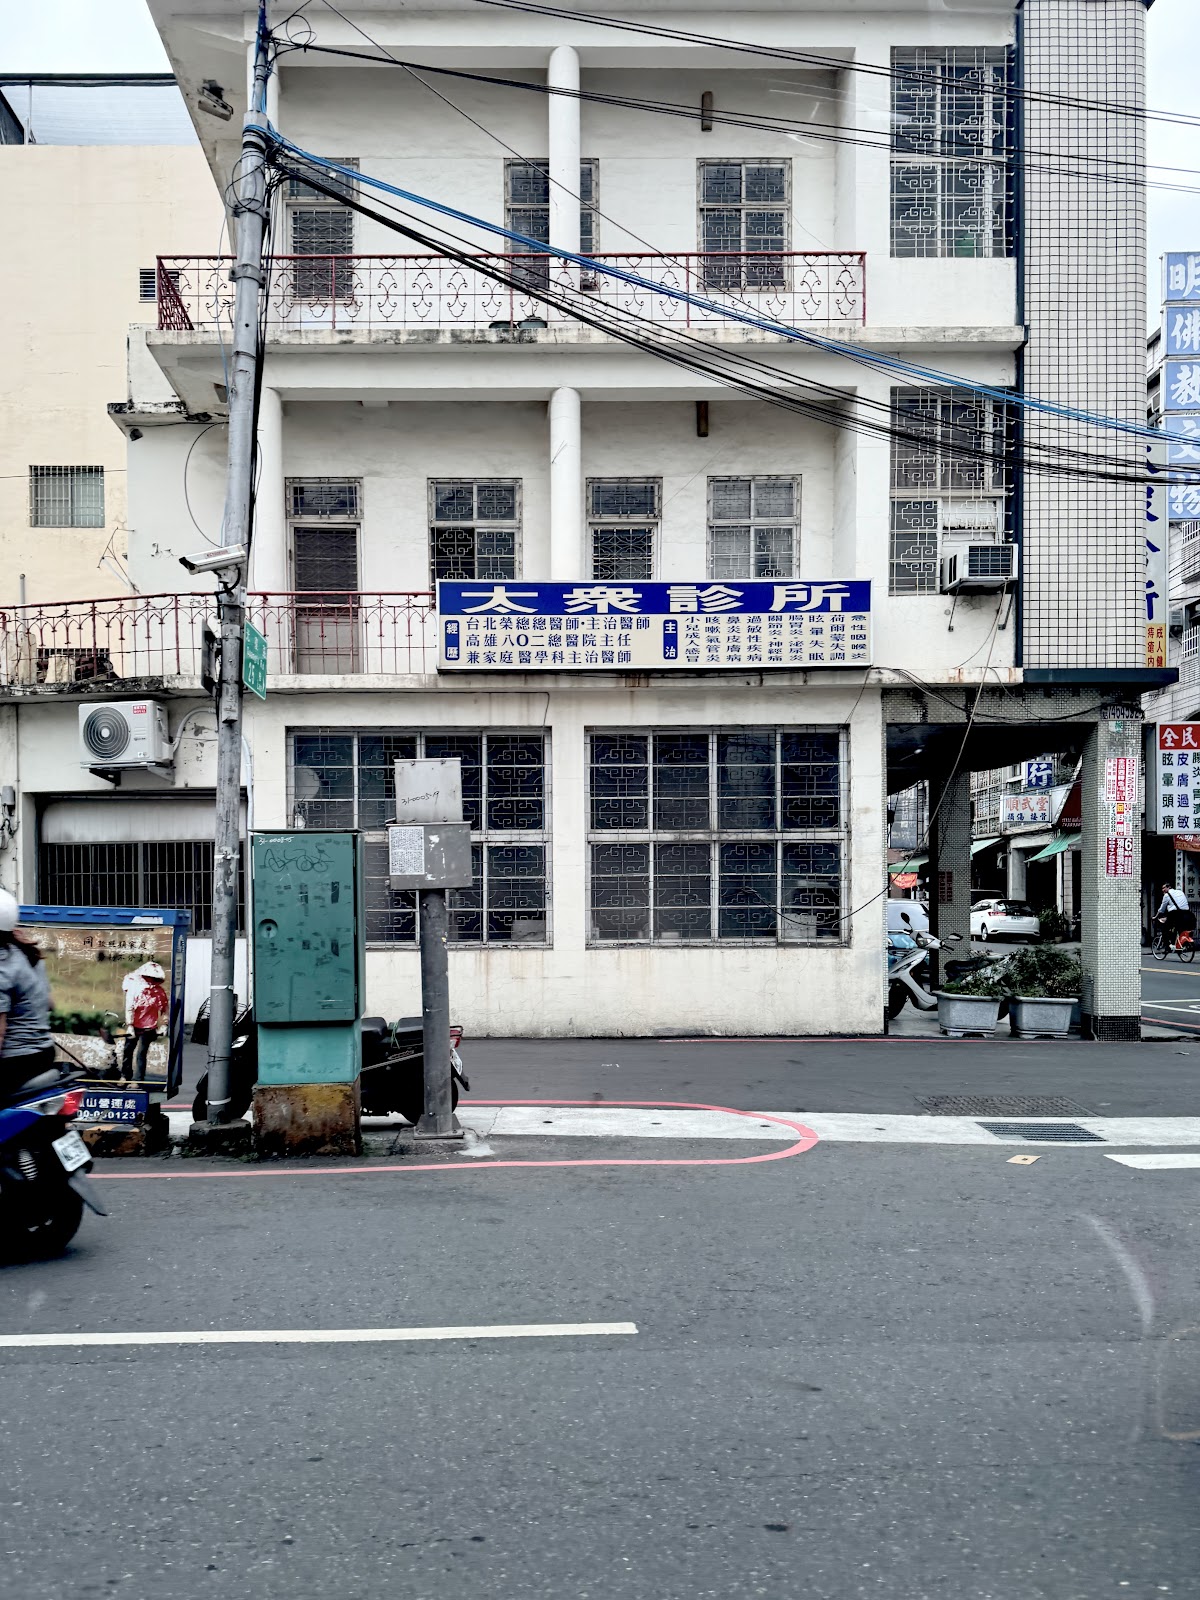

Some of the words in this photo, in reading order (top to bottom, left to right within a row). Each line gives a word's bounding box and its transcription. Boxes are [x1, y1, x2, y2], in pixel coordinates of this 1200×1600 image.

[466, 650, 632, 664] 兼家庭醫學科主治醫師
[664, 621, 677, 658] 主治
[685, 616, 700, 662] 小兒成人感冒
[705, 616, 721, 662] 咳嗽氣管炎
[726, 616, 742, 662] 鼻炎皮膚病
[747, 615, 762, 662] 過敏性疾病
[808, 615, 824, 661] 眩暈失眠
[829, 615, 845, 661] 荷爾蒙失調
[851, 615, 867, 659] 急性咽喉炎
[1161, 726, 1198, 748] 全民
[1028, 763, 1052, 787] 行
[1162, 752, 1174, 829] 眩暈頭痛
[1177, 752, 1190, 829] 皮膚過敏
[1006, 796, 1049, 812] 順武堂
